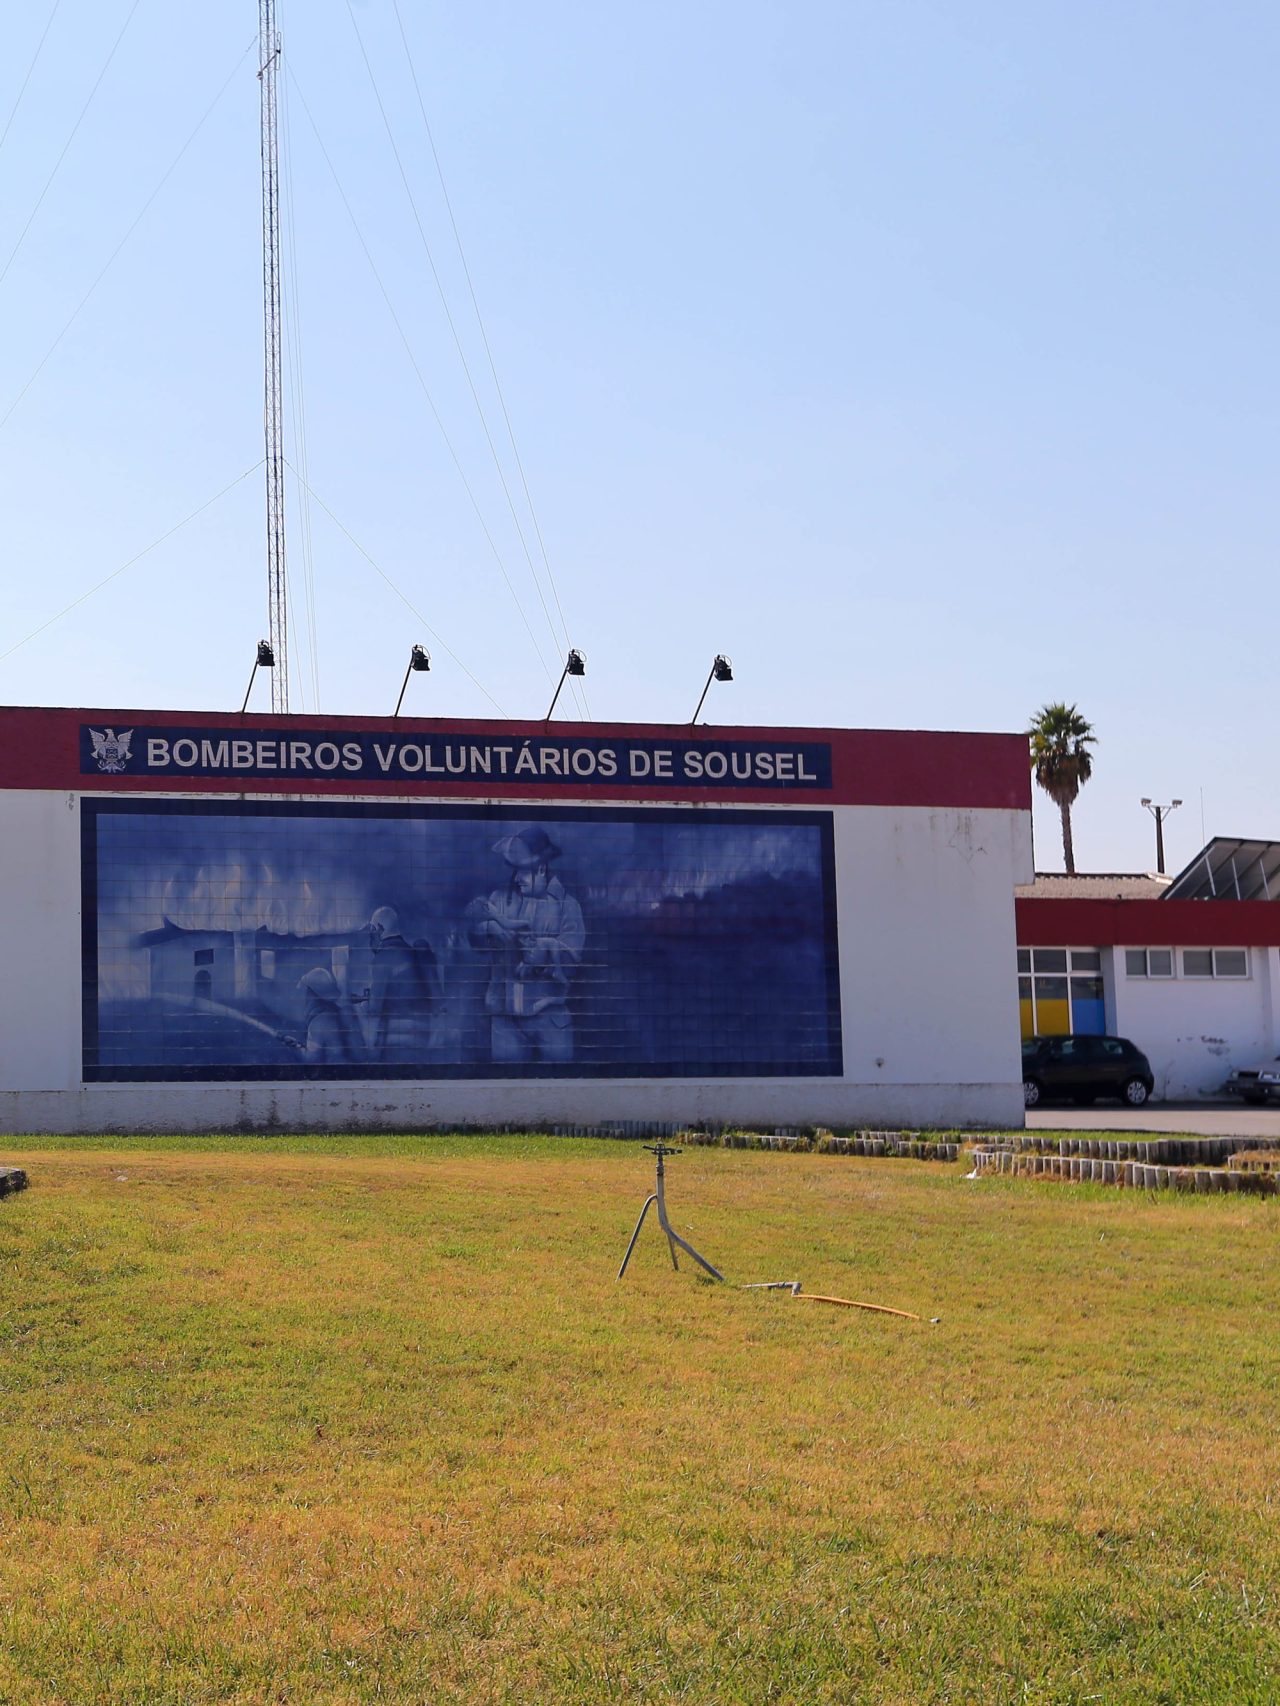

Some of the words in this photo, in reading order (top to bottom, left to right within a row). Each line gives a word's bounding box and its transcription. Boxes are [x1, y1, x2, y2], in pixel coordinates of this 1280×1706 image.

[146, 738, 363, 770] BOMBEIROS
[372, 740, 618, 776] VOLUNTÁRIOS
[629, 750, 674, 777] DE
[683, 751, 817, 780] SOUSEL
